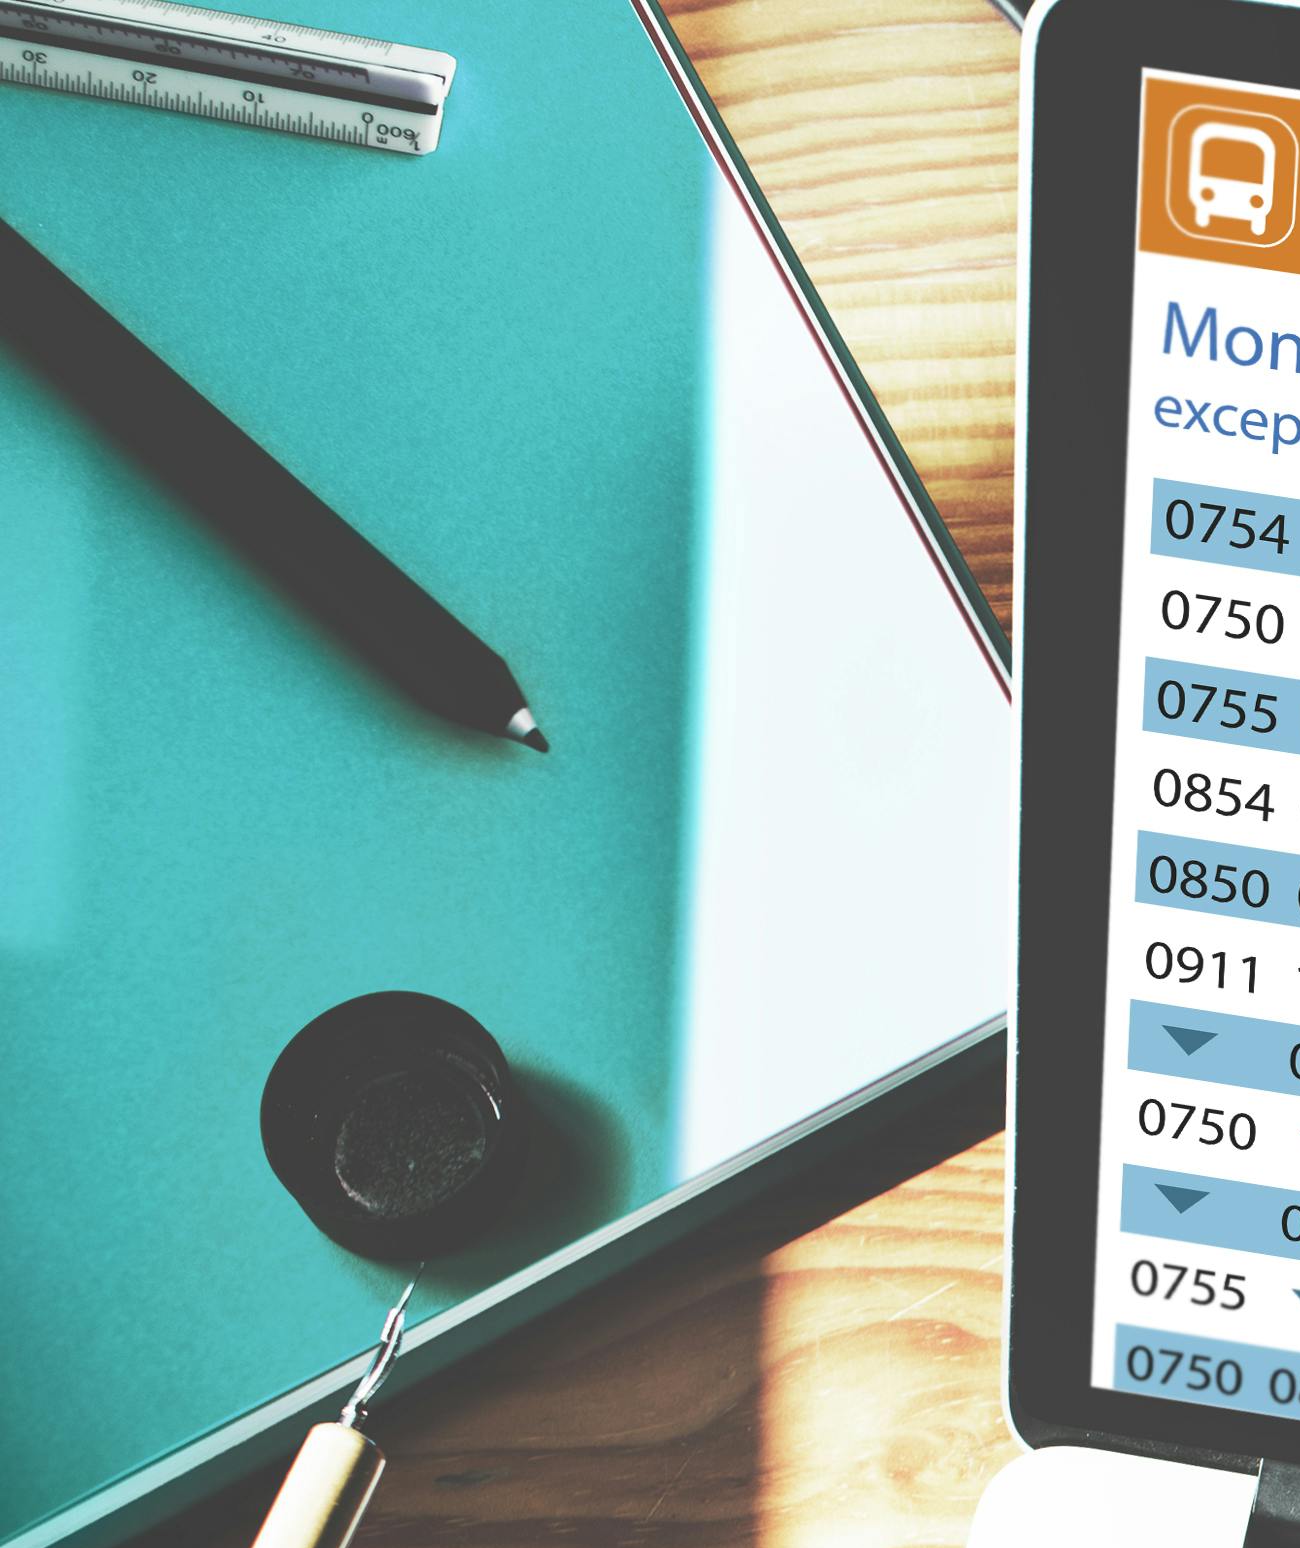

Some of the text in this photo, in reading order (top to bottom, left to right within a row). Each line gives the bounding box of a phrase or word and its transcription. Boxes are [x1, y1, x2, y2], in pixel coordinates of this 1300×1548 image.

[22, 50, 48, 64] 30
[132, 70, 158, 84] 20
[242, 90, 264, 104] 10
[1165, 499, 1290, 555] 0754
[1153, 768, 1275, 822] 0854
[1127, 1346, 1242, 1395] 0750
